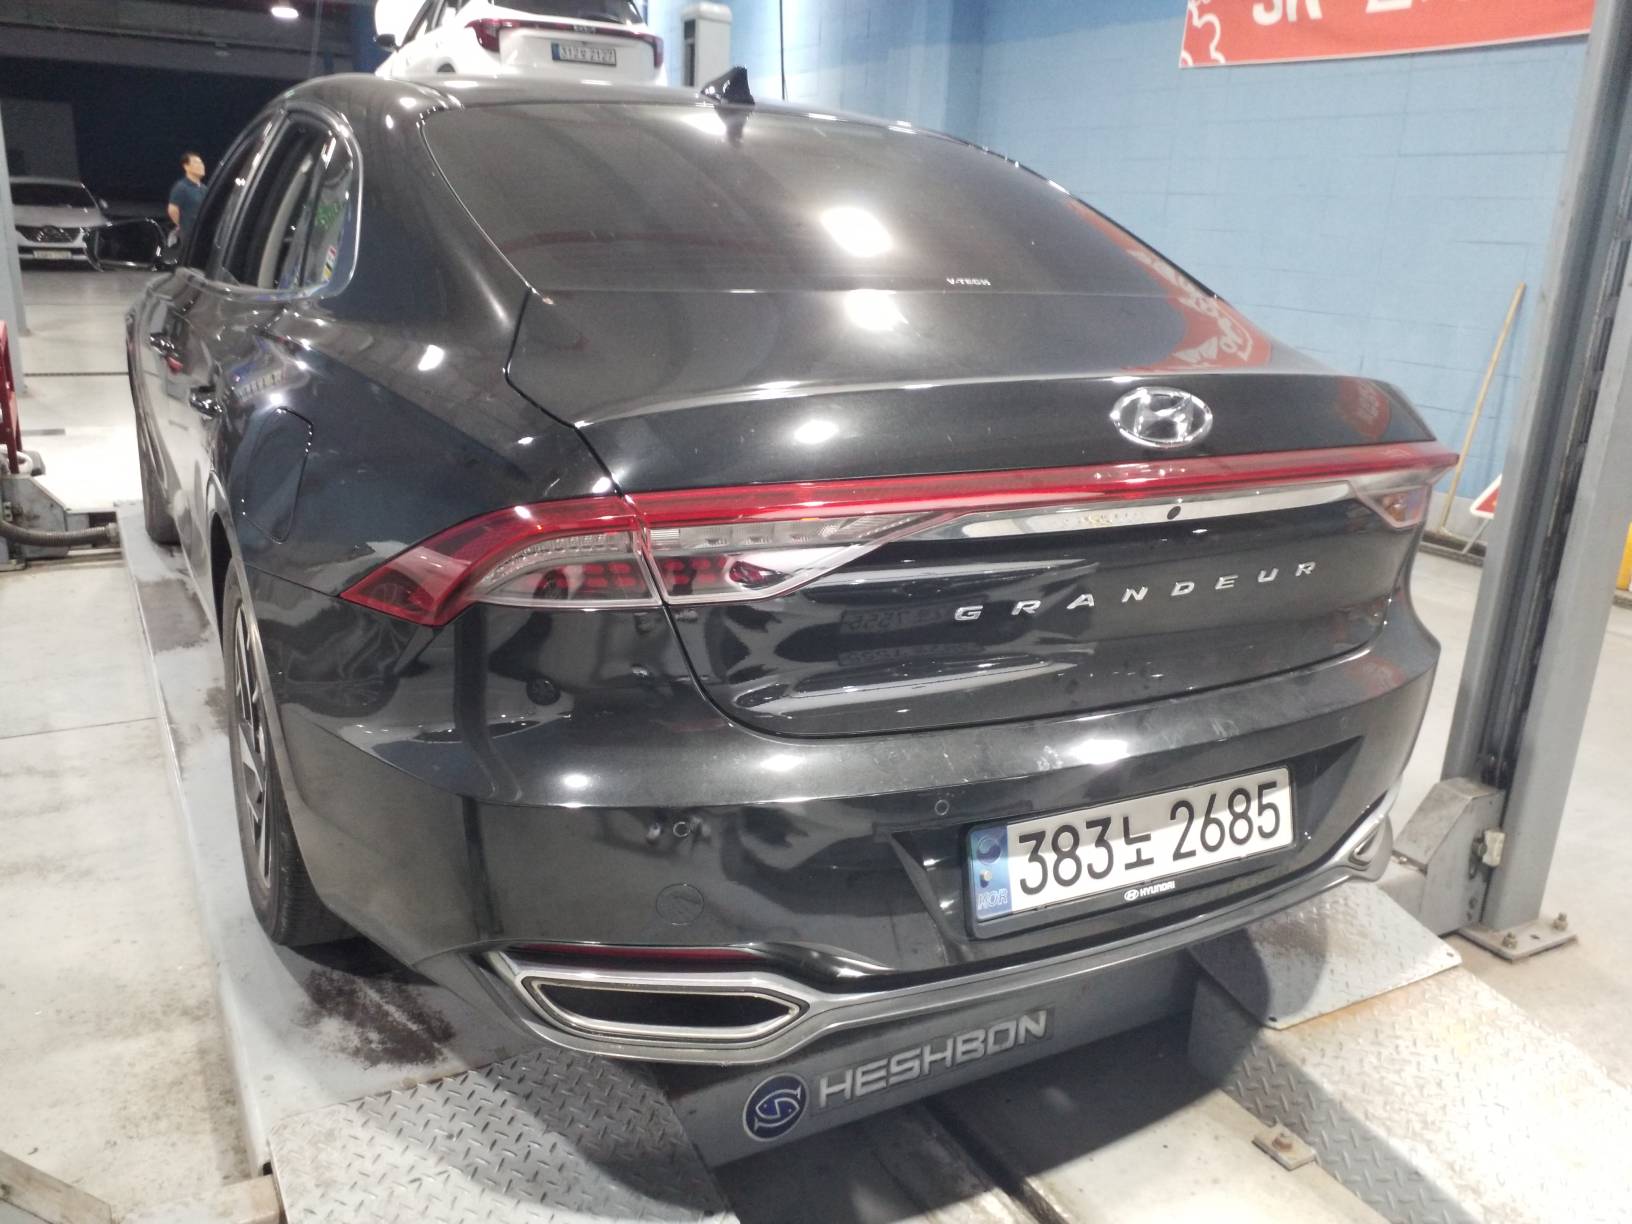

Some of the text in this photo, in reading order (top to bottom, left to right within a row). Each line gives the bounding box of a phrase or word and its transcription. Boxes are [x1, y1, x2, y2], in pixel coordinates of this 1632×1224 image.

[954, 561, 1316, 621] GRANDEUR
[1018, 780, 1281, 896] 383노 2685
[1140, 880, 1176, 897] HYUNDAI
[818, 1009, 1048, 1108] HESHBON
